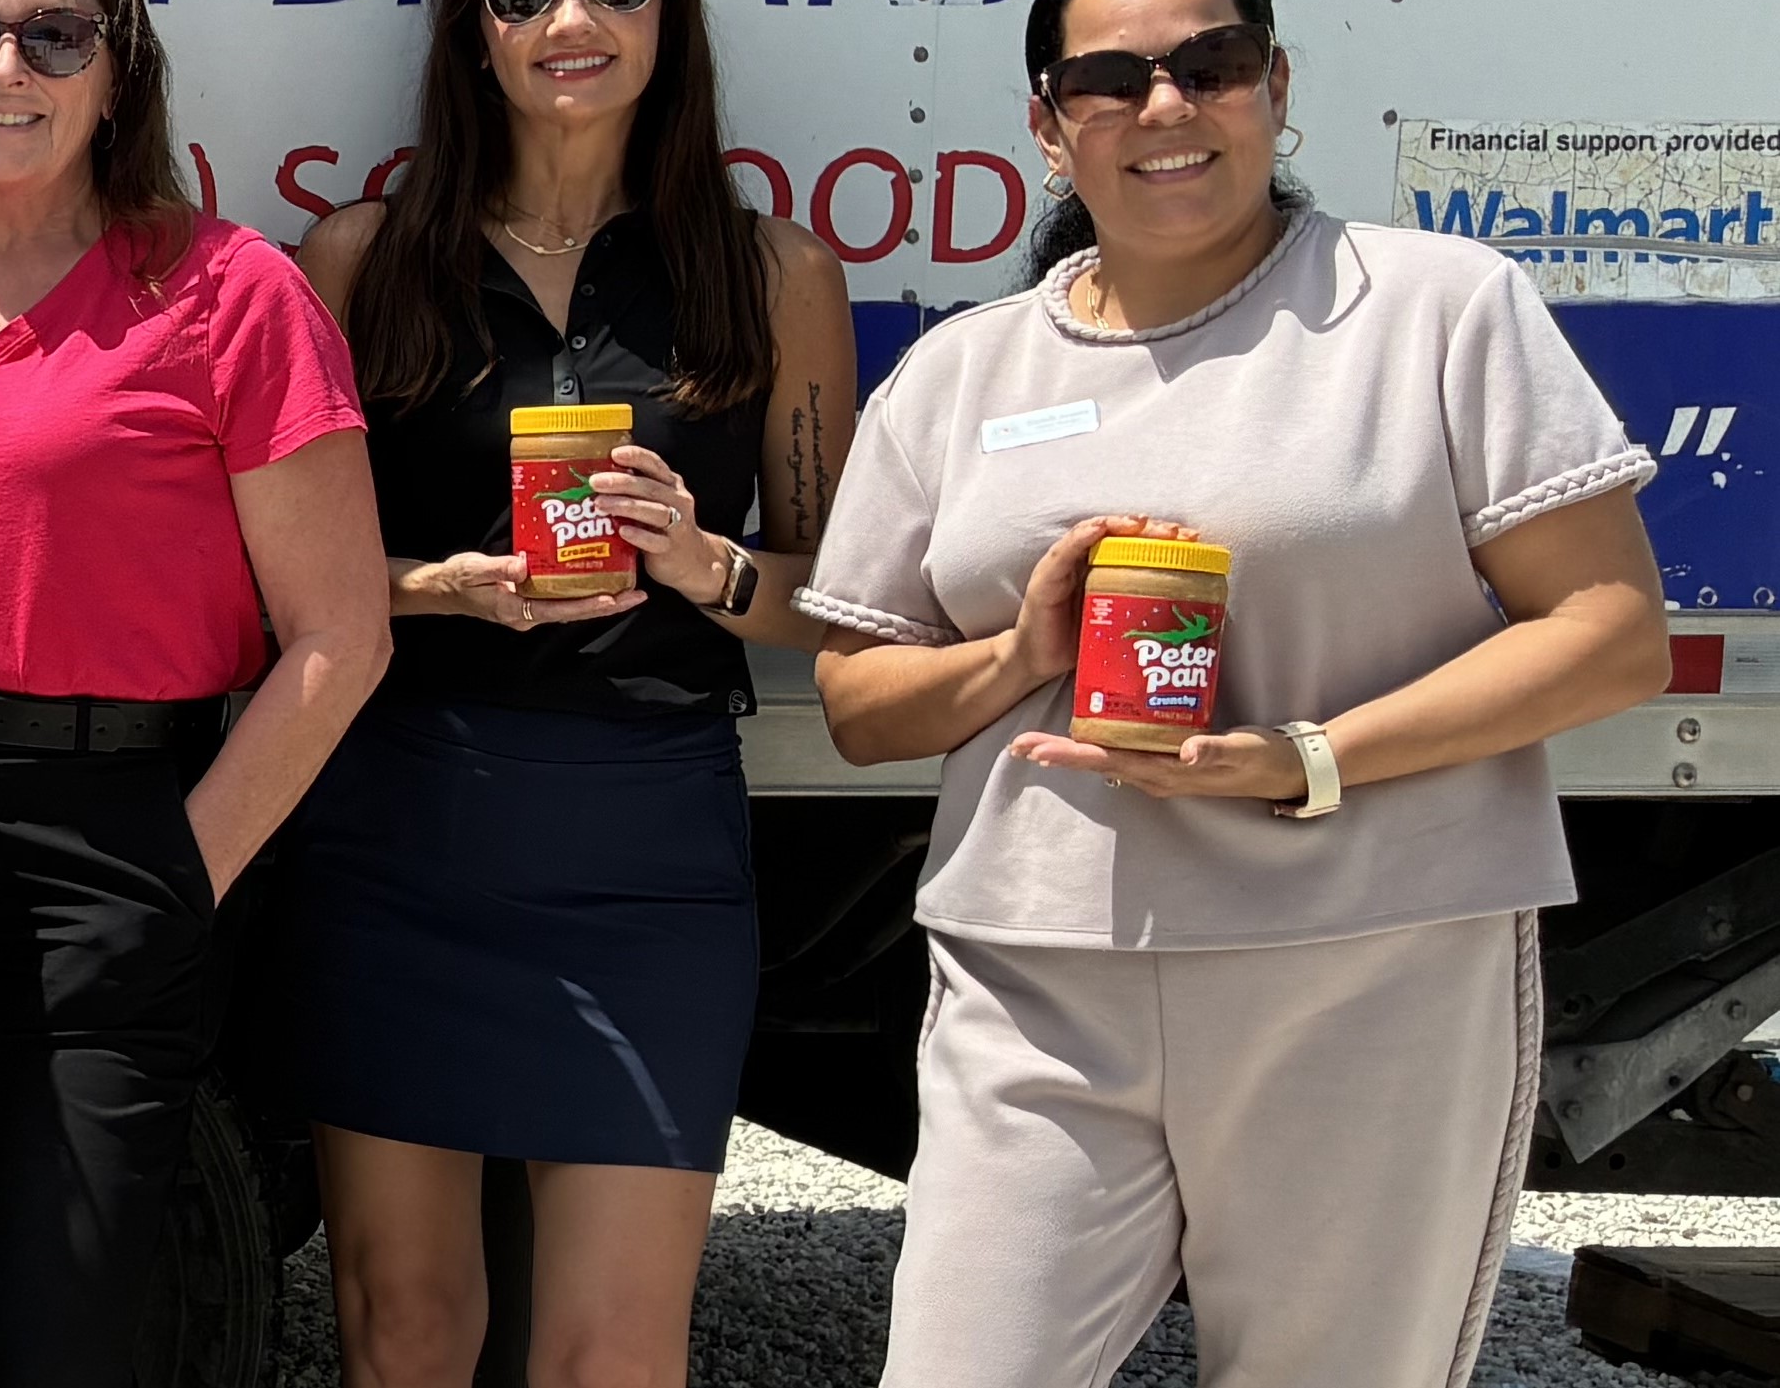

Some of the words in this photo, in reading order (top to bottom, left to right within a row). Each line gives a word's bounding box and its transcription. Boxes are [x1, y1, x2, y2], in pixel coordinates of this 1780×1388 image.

[1429, 127, 1549, 152] Financial
[551, 516, 615, 547] Pan
[1132, 639, 1217, 669] Peter
[1142, 665, 1209, 694] Pan
